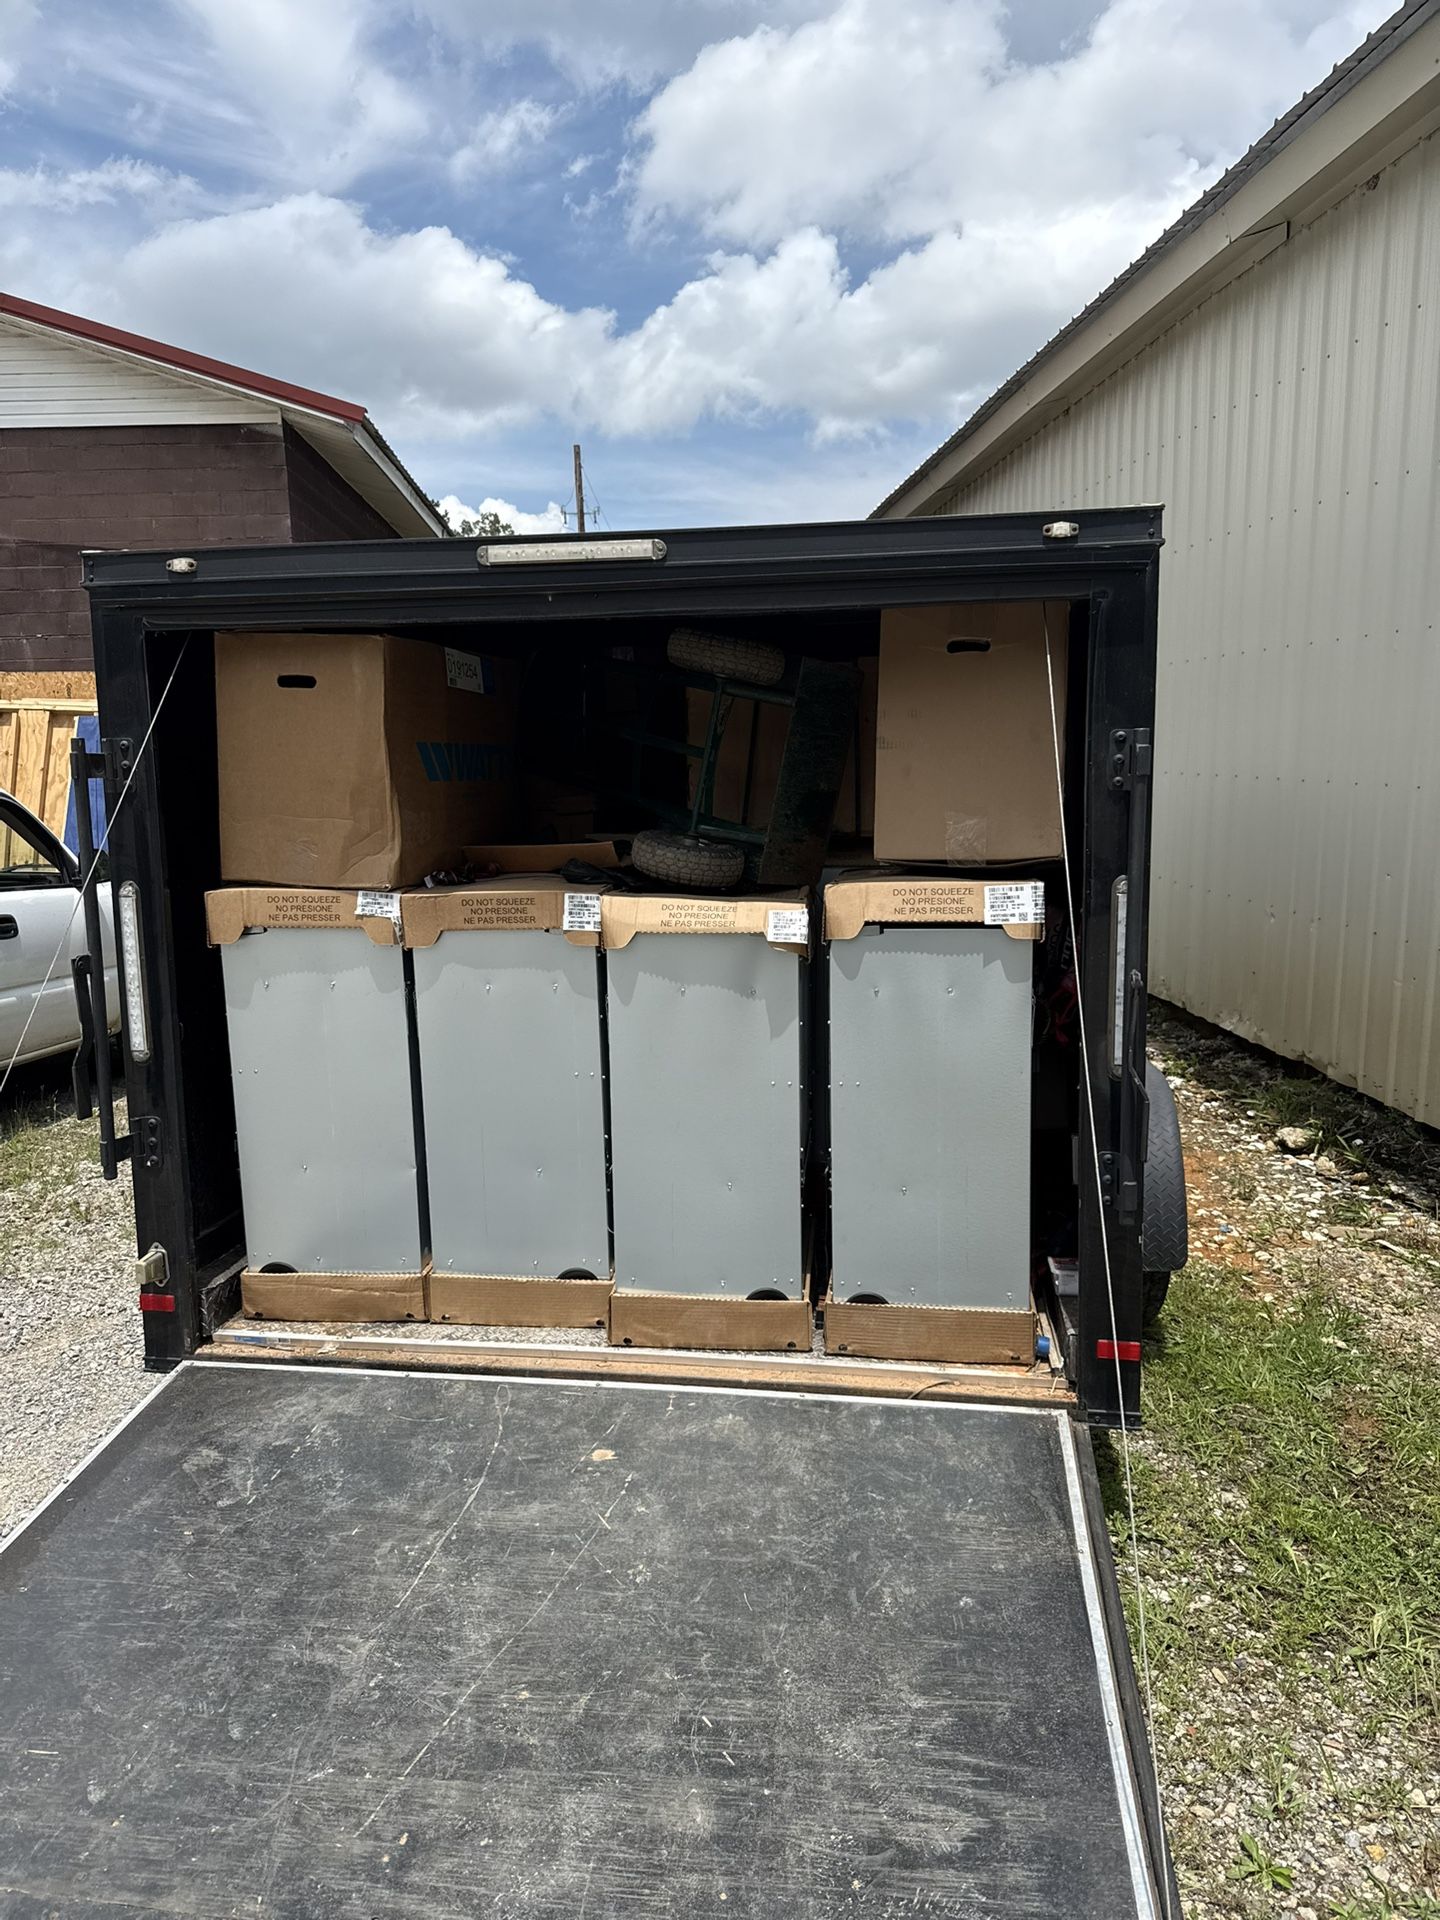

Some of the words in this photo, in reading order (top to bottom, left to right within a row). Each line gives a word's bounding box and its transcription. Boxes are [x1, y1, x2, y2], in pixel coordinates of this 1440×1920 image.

[447, 657, 478, 680] 0191254
[267, 896, 280, 904] DO
[282, 896, 300, 904] NOT
[301, 896, 341, 904] SQUEEZE
[918, 897, 966, 905] PRESIONE
